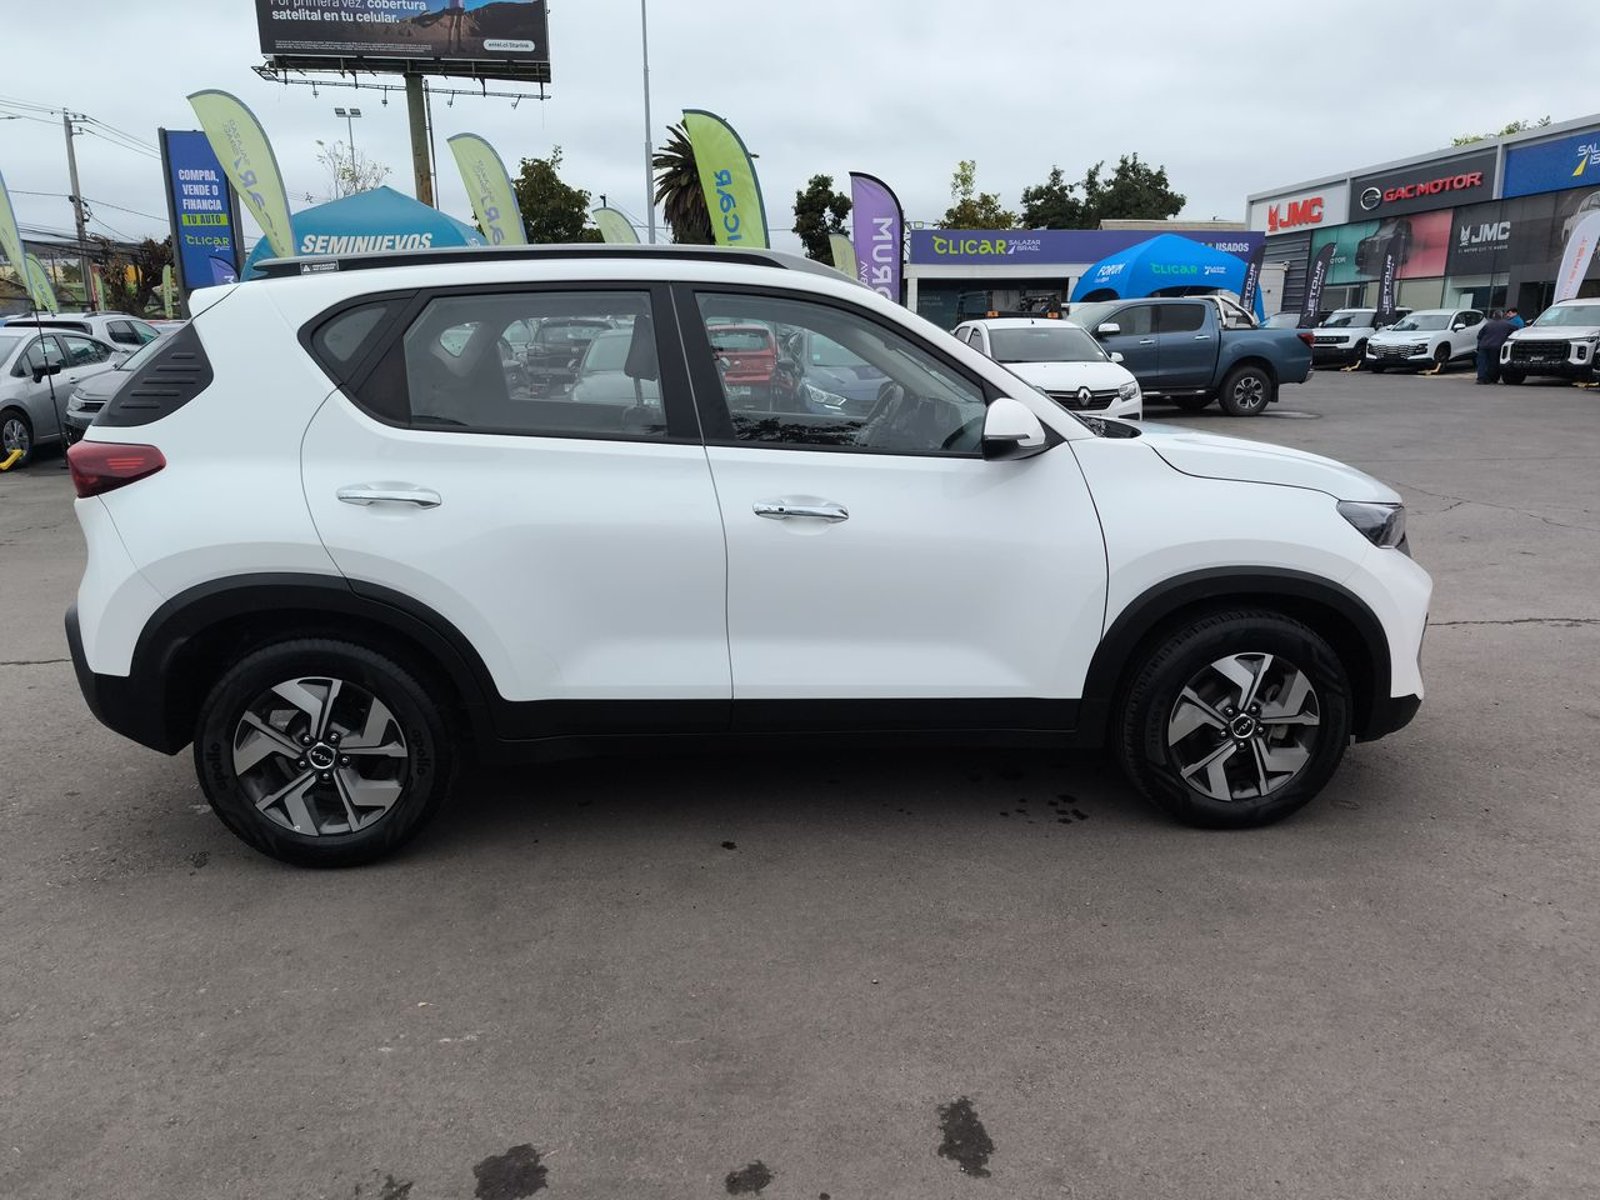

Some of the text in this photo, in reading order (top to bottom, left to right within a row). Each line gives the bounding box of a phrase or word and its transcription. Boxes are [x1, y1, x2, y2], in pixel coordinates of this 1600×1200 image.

[342, 0, 365, 9] vez,
[367, 0, 427, 10] cobertura
[272, 9, 400, 24] satelital en tu celular.
[178, 169, 219, 182] COMPRA,
[182, 184, 219, 196] VENDE O
[1383, 171, 1483, 202] GAC MOTOR
[183, 199, 222, 211] FINANCIA
[1279, 196, 1324, 228] JMC
[187, 214, 222, 225] TU AUTO
[1471, 221, 1511, 243] JMC
[301, 232, 433, 255] SEMINUEVOS
[1307, 260, 1323, 317] JETOUR
[1381, 254, 1392, 315] JETOUR
